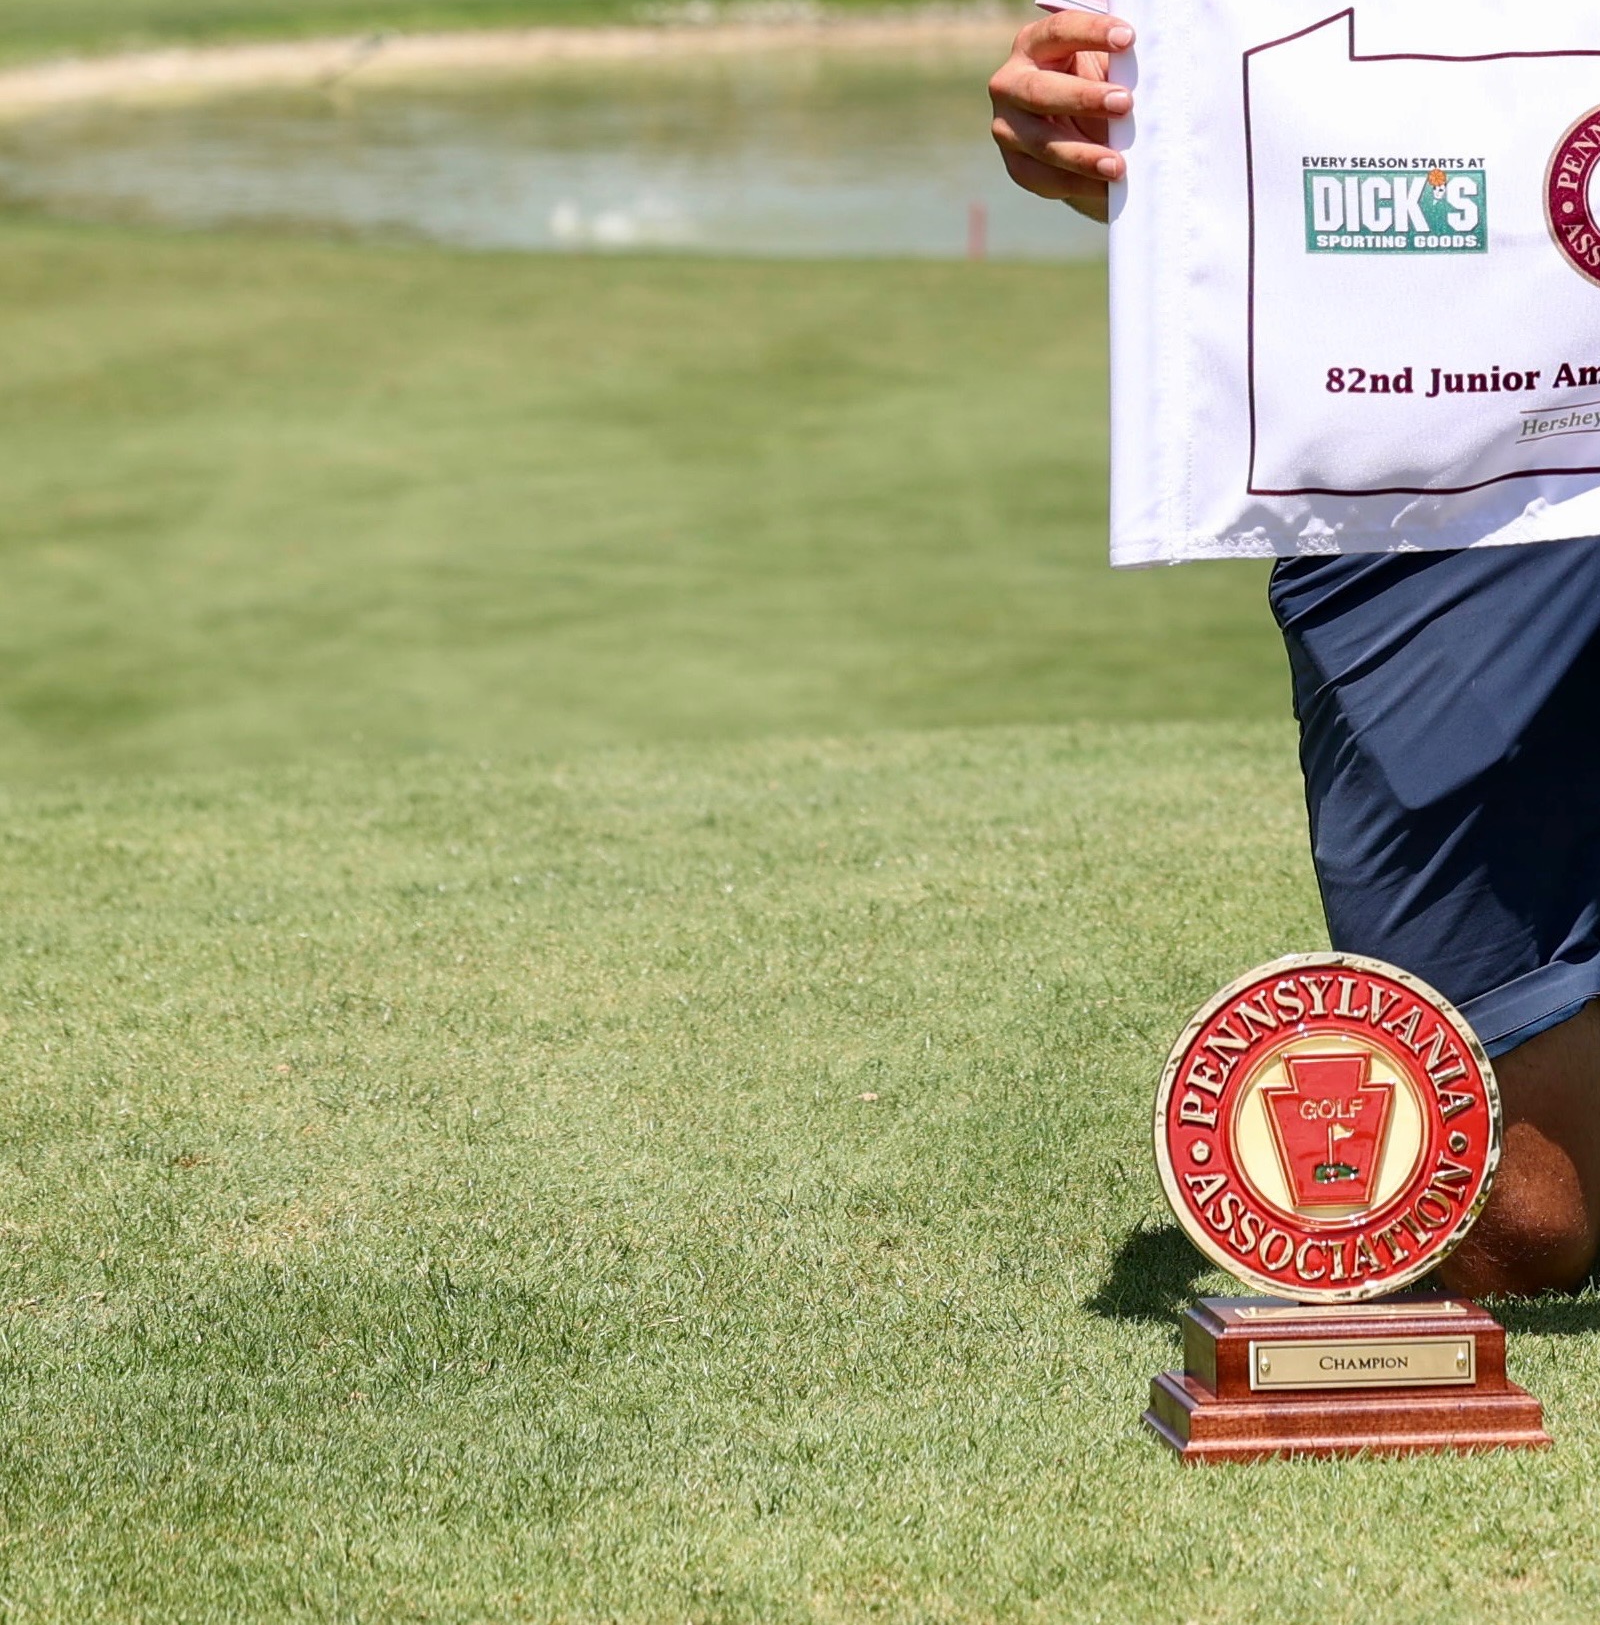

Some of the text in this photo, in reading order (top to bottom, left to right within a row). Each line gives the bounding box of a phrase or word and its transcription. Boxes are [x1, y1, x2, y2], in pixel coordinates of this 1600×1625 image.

[1302, 156, 1486, 169] EVERY SEASON STARTS AT
[1312, 173, 1479, 233] DICK'S
[1316, 234, 1408, 249] SPORTING
[1325, 366, 1414, 394] 82nd
[1425, 365, 1541, 399] Junior
[1177, 974, 1476, 1128] PENNSYLVANIA
[1298, 1097, 1365, 1122] GOLF
[1183, 1152, 1473, 1282] ASSOCIATION
